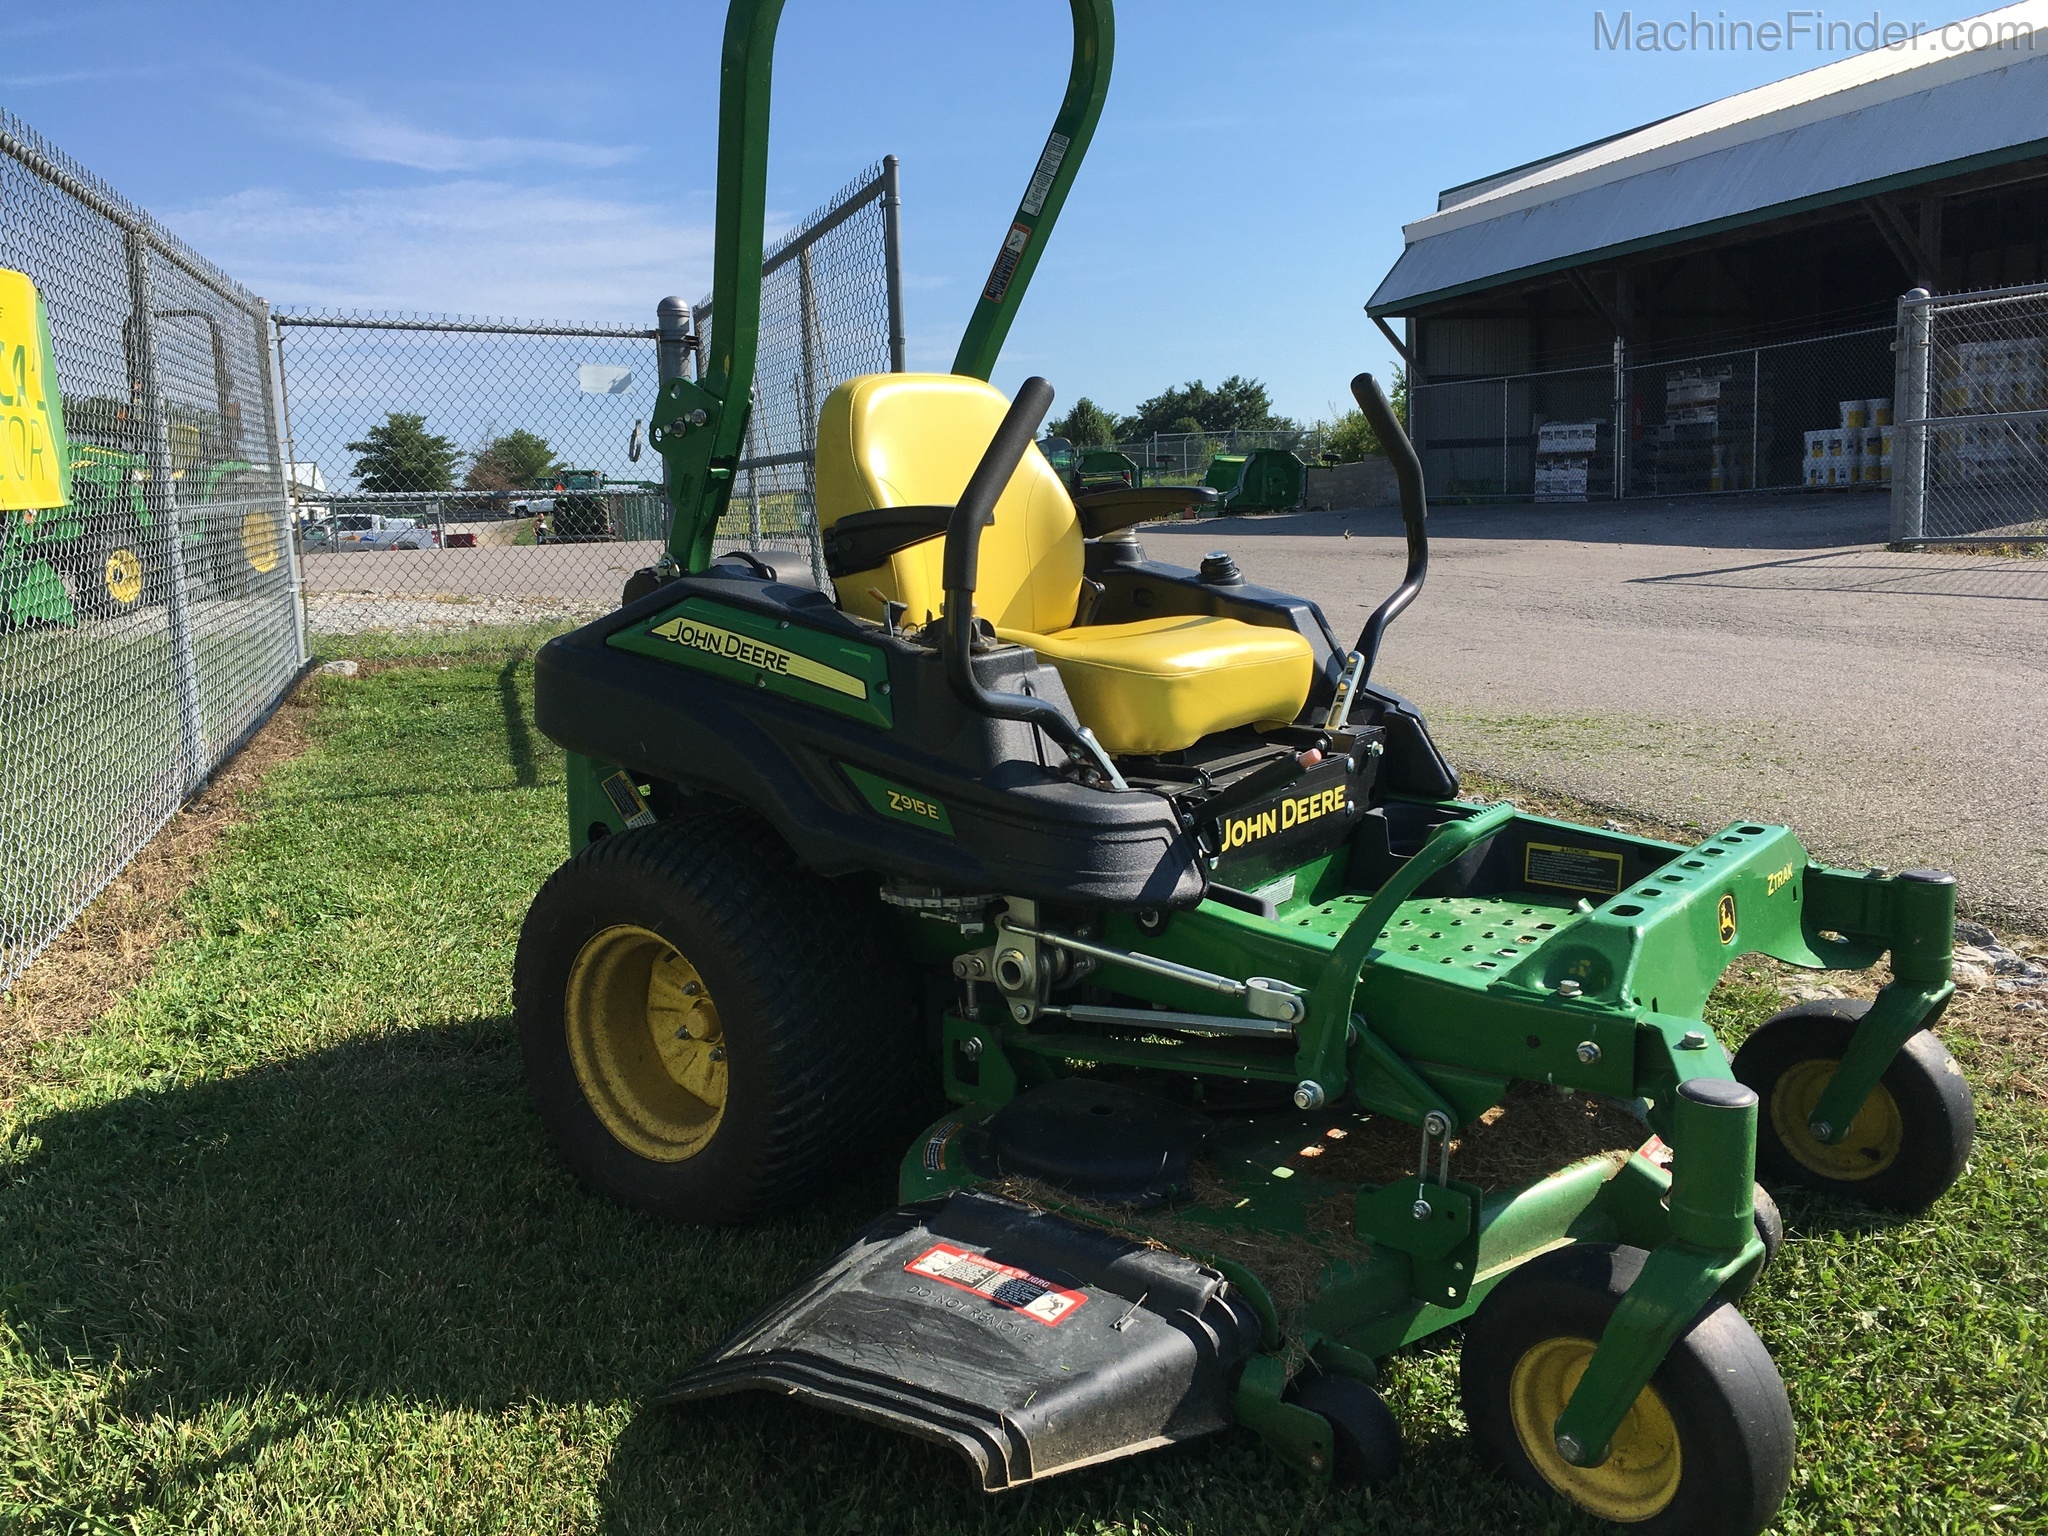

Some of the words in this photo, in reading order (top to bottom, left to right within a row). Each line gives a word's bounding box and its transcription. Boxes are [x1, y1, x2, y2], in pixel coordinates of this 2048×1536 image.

[668, 621, 723, 652] JOHN
[725, 634, 791, 673] DEERE
[887, 790, 940, 820] Z915E
[1221, 808, 1277, 852] JOHN
[1281, 784, 1346, 830] DEERE
[968, 1255, 1003, 1271] DANGER
[1013, 1269, 1051, 1288] PELIGRO
[906, 1284, 932, 1299] DO
[935, 1291, 969, 1314] NOT
[970, 1306, 1036, 1344] REMOVE
